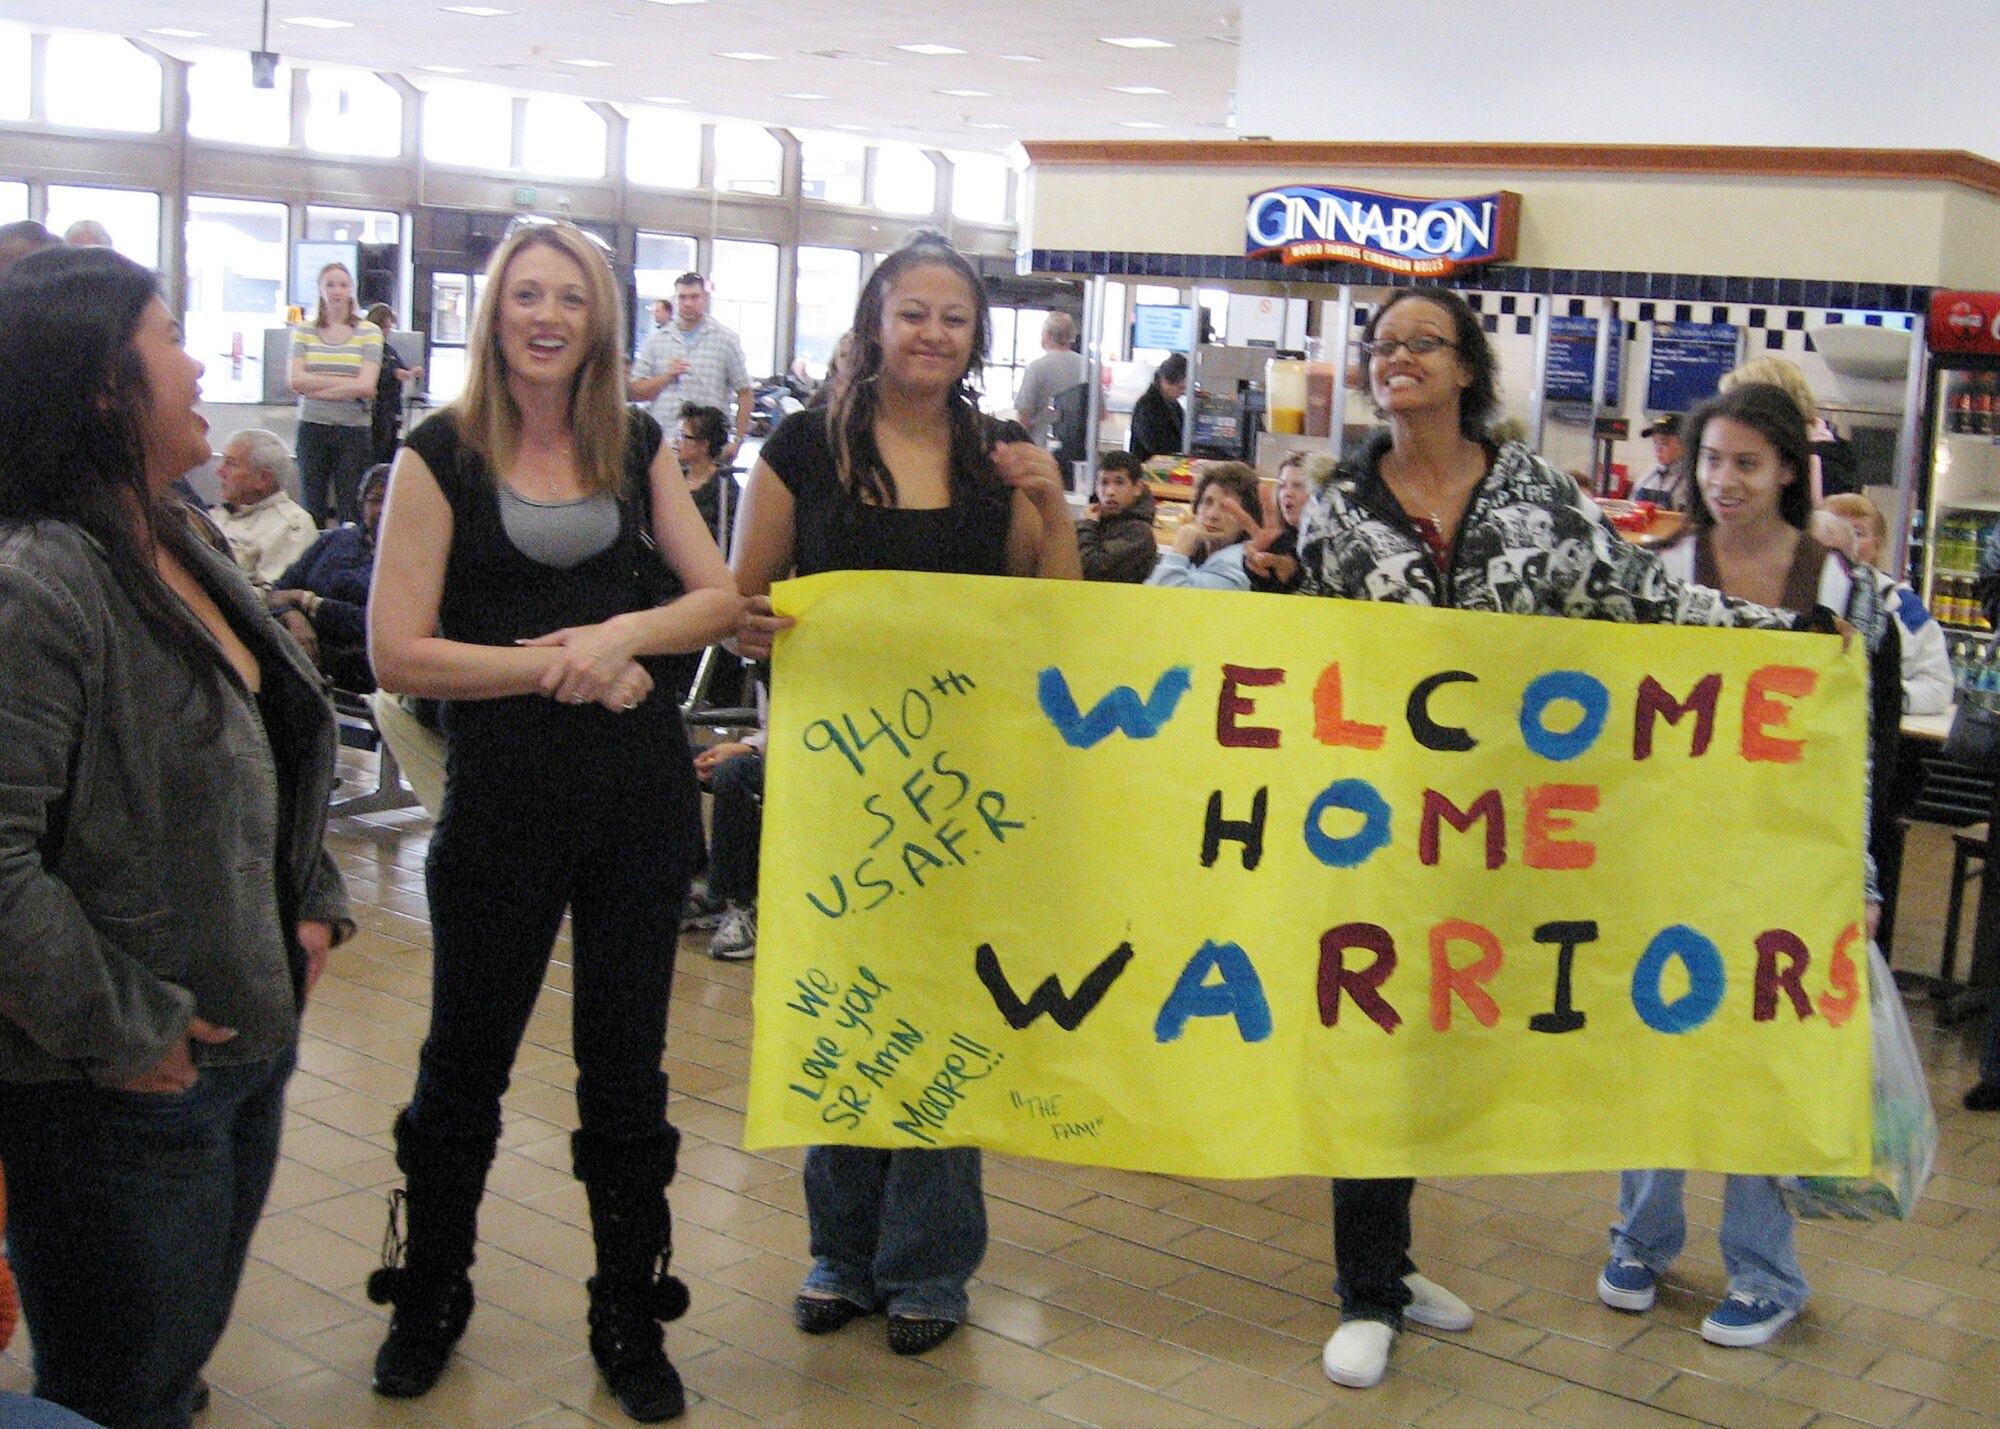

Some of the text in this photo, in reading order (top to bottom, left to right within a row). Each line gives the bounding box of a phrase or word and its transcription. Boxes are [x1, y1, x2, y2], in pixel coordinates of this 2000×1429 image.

[1248, 192, 1493, 254] CINNABON
[803, 669, 976, 776] 940th
[1037, 659, 1818, 763] WELCOME
[864, 751, 970, 849] SFS
[1200, 777, 1600, 870] HOME
[836, 965, 892, 1040] you
[976, 920, 1861, 1044] WARRIORS
